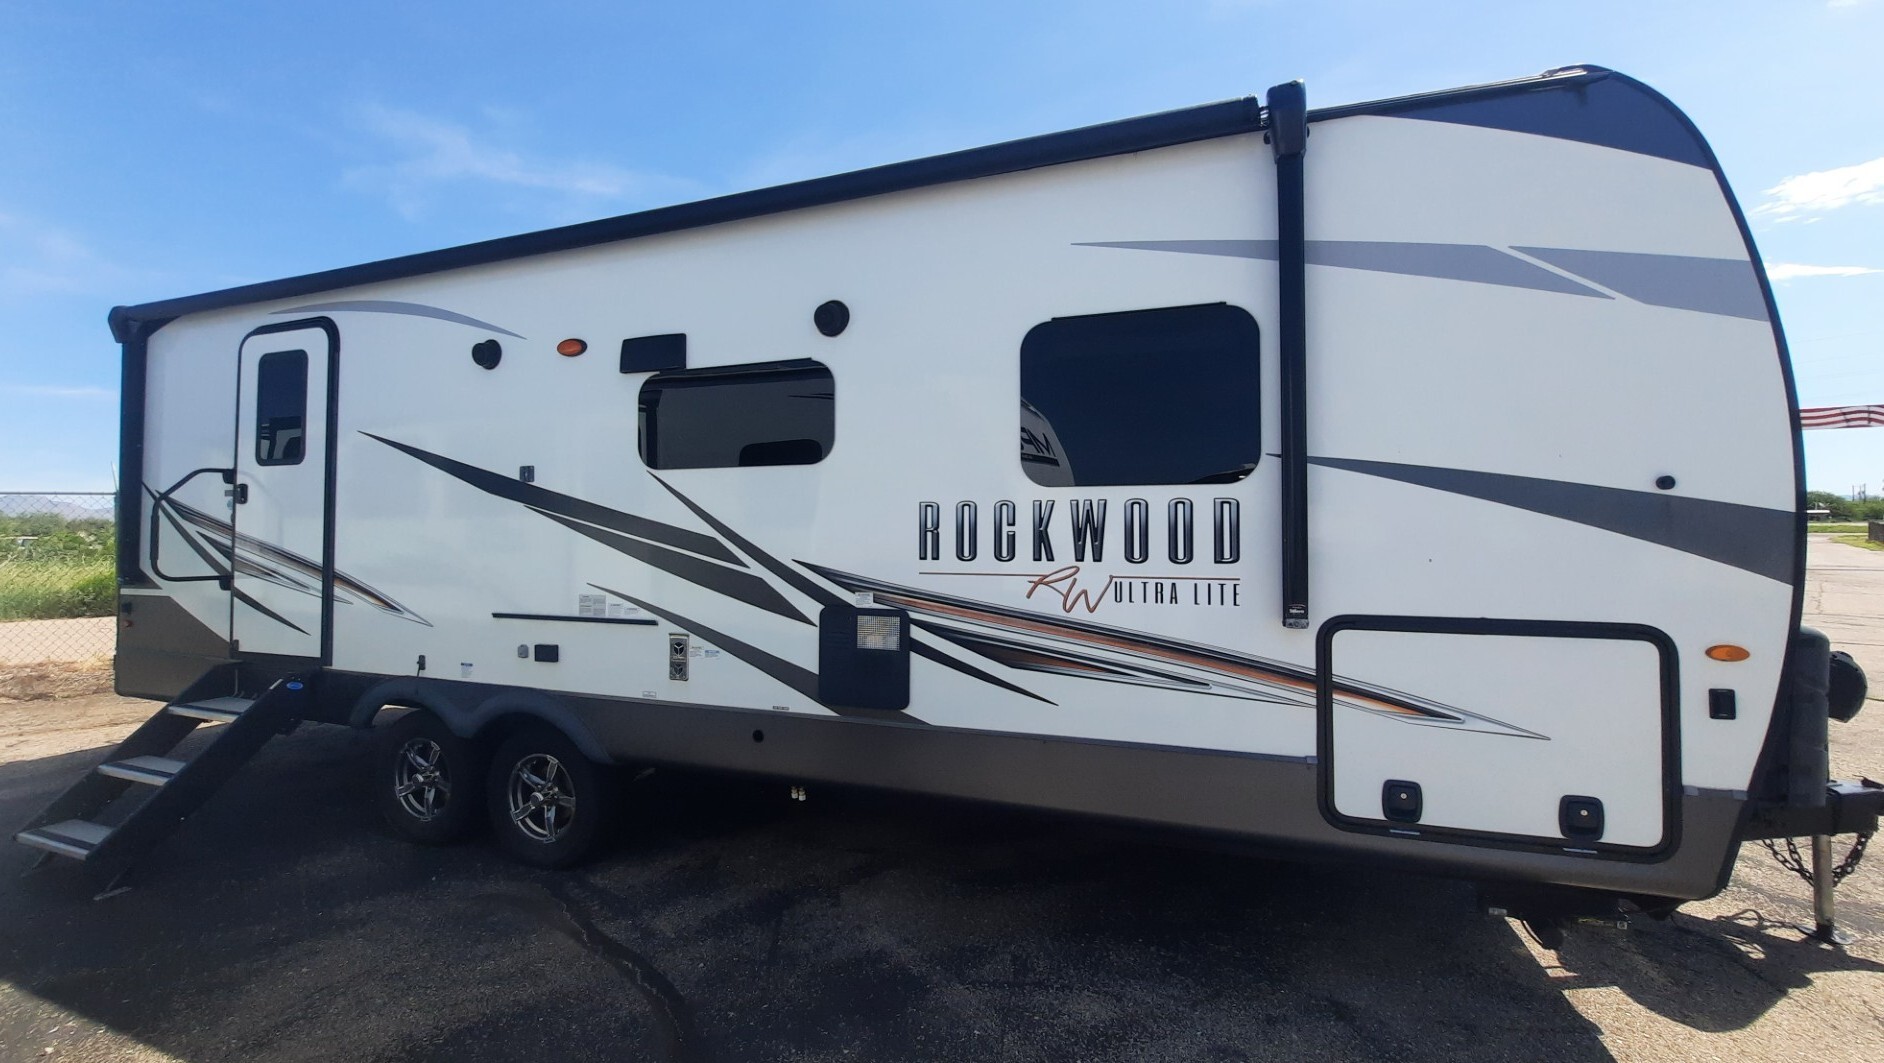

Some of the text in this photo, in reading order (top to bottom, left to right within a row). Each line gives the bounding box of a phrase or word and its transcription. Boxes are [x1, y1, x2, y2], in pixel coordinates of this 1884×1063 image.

[918, 497, 1241, 564] ROCKWOOD
[1026, 565, 1114, 613] RW
[1114, 581, 1241, 606] ULTRA LITE
